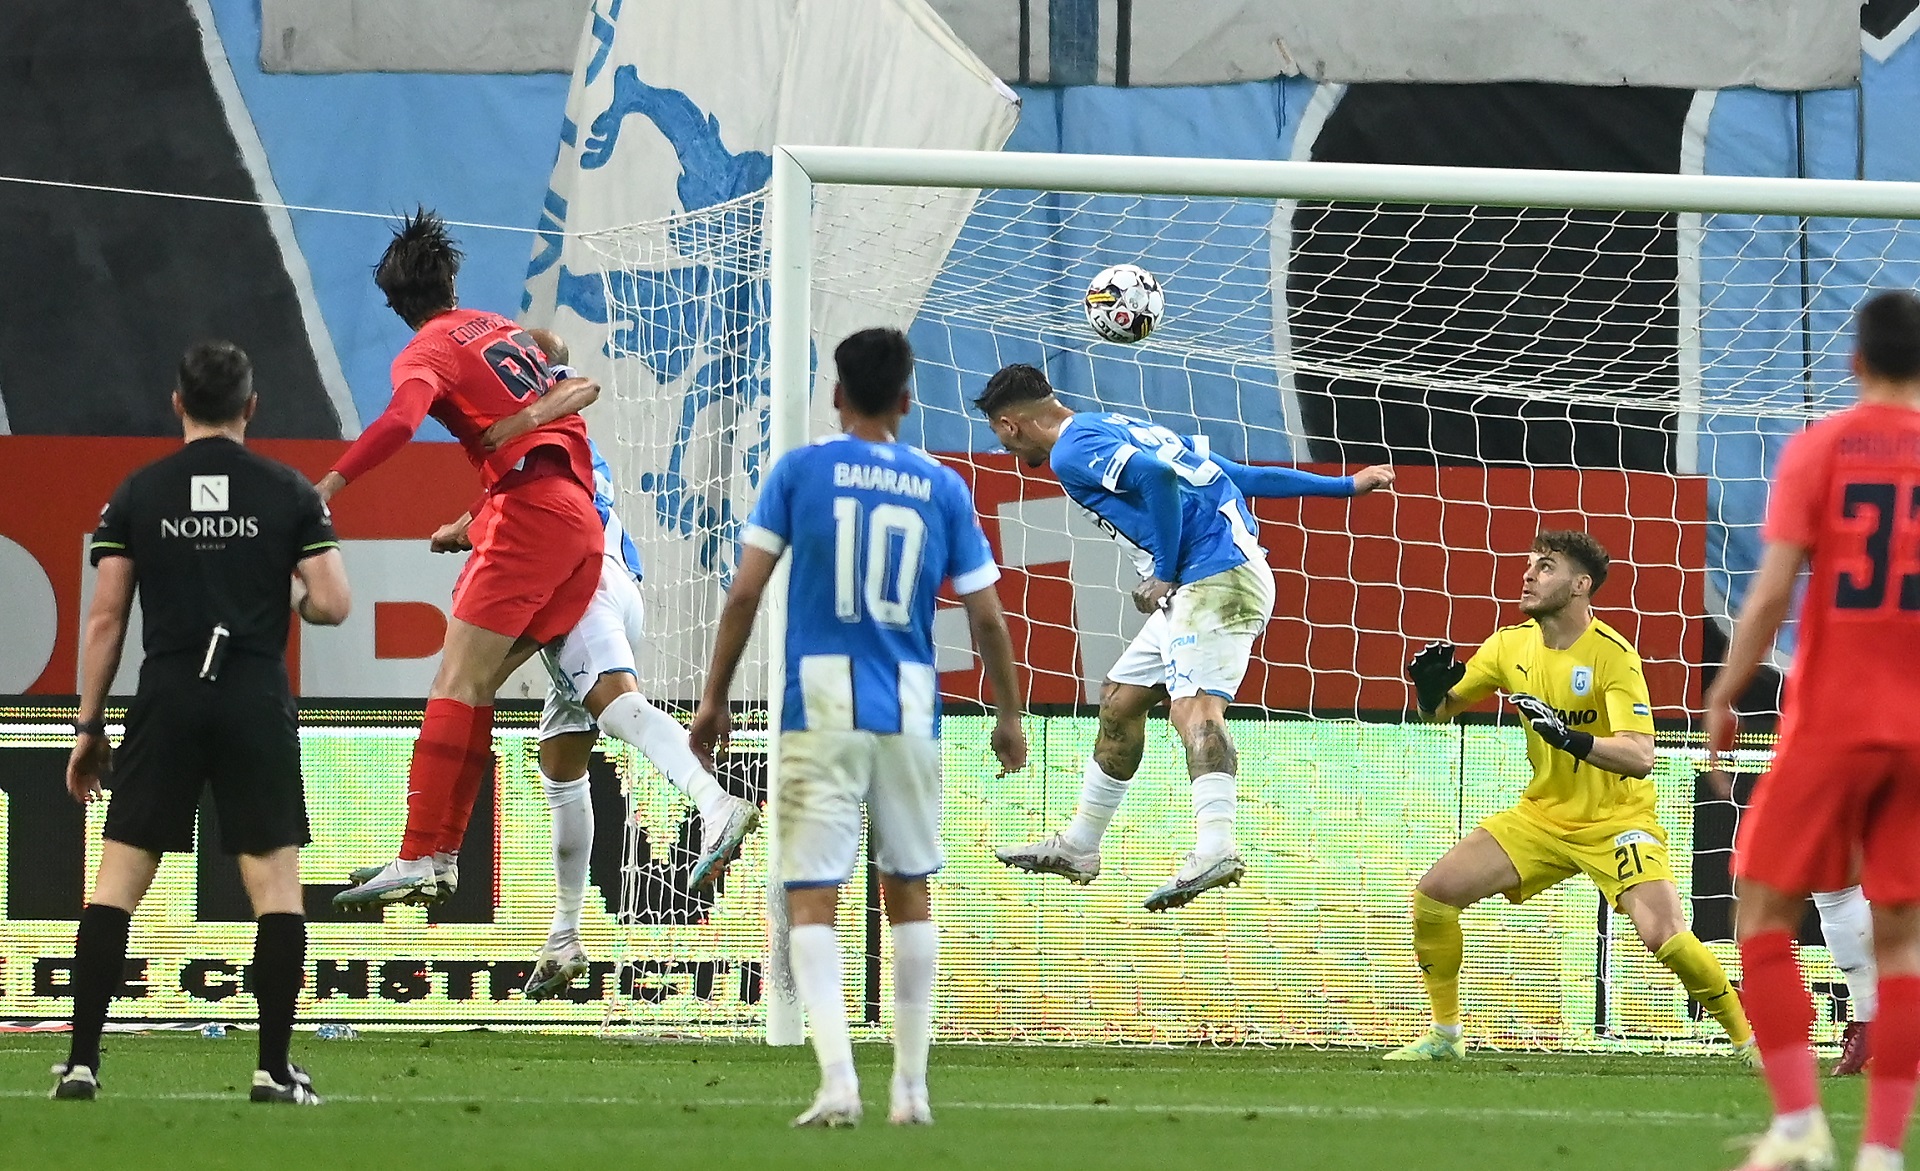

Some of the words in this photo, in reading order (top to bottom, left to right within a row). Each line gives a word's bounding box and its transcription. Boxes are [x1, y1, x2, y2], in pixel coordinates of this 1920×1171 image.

[833, 462, 931, 502] BAIARAM
[160, 516, 259, 538] NORDIS
[833, 496, 928, 632] 10
[1615, 843, 1643, 881] 21
